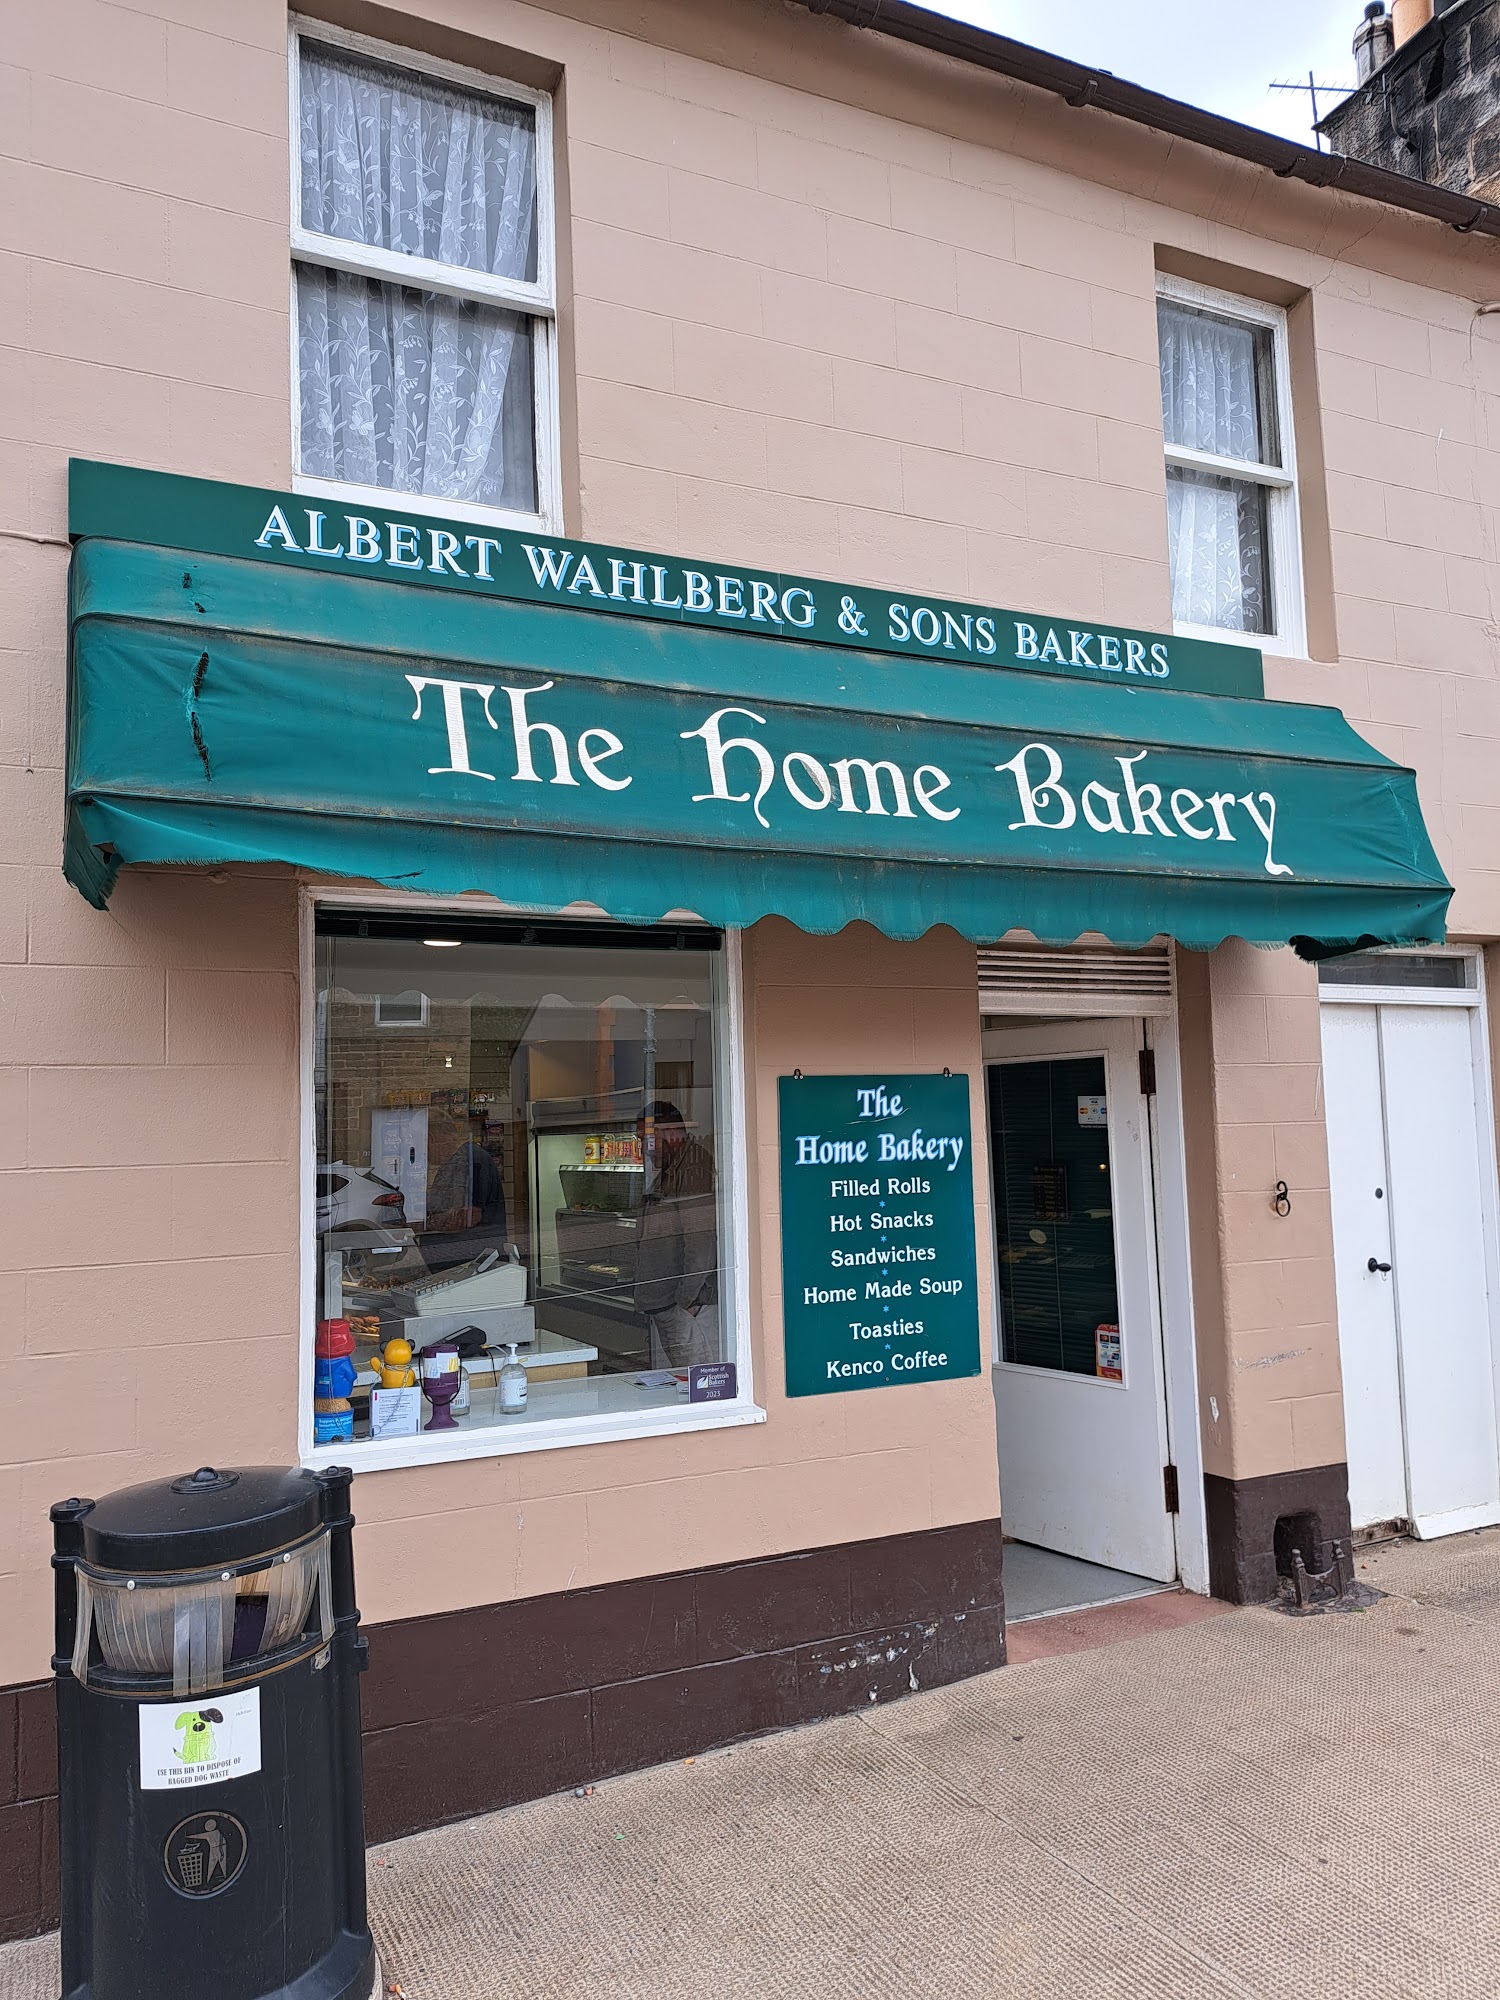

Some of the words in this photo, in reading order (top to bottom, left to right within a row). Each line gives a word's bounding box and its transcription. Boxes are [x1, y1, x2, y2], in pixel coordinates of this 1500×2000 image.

[254, 504, 502, 581] ALBERT
[521, 543, 817, 628] WAHLBERG
[838, 595, 869, 637] &
[888, 603, 996, 656] SONS
[1014, 621, 1170, 679] BAKERS
[405, 674, 633, 792] The
[680, 707, 961, 829] Home
[995, 742, 1294, 876] Bakery
[856, 1085, 904, 1118] The
[795, 1134, 869, 1166] Home
[877, 1128, 964, 1172] Bakery
[830, 1178, 880, 1198] Filled
[888, 1177, 931, 1195] Rolls
[830, 1214, 863, 1232] Hot
[870, 1211, 934, 1230] Snacks
[830, 1246, 937, 1267] Sandwiches
[803, 1285, 857, 1305] Home
[865, 1280, 913, 1299] Made
[919, 1277, 963, 1297] Soup
[849, 1318, 925, 1341] Toasties
[826, 1358, 884, 1379] Kenco
[890, 1351, 948, 1371] Coffee
[157, 1768, 167, 1777] USE
[168, 1767, 183, 1776] THIS
[183, 1765, 195, 1775] BIN
[196, 1764, 206, 1773] TO
[206, 1759, 232, 1770] DISPOSE
[233, 1756, 242, 1765] OF
[168, 1776, 193, 1785] BAGGED
[194, 1774, 208, 1783] DOG
[209, 1770, 230, 1780] WASTE
